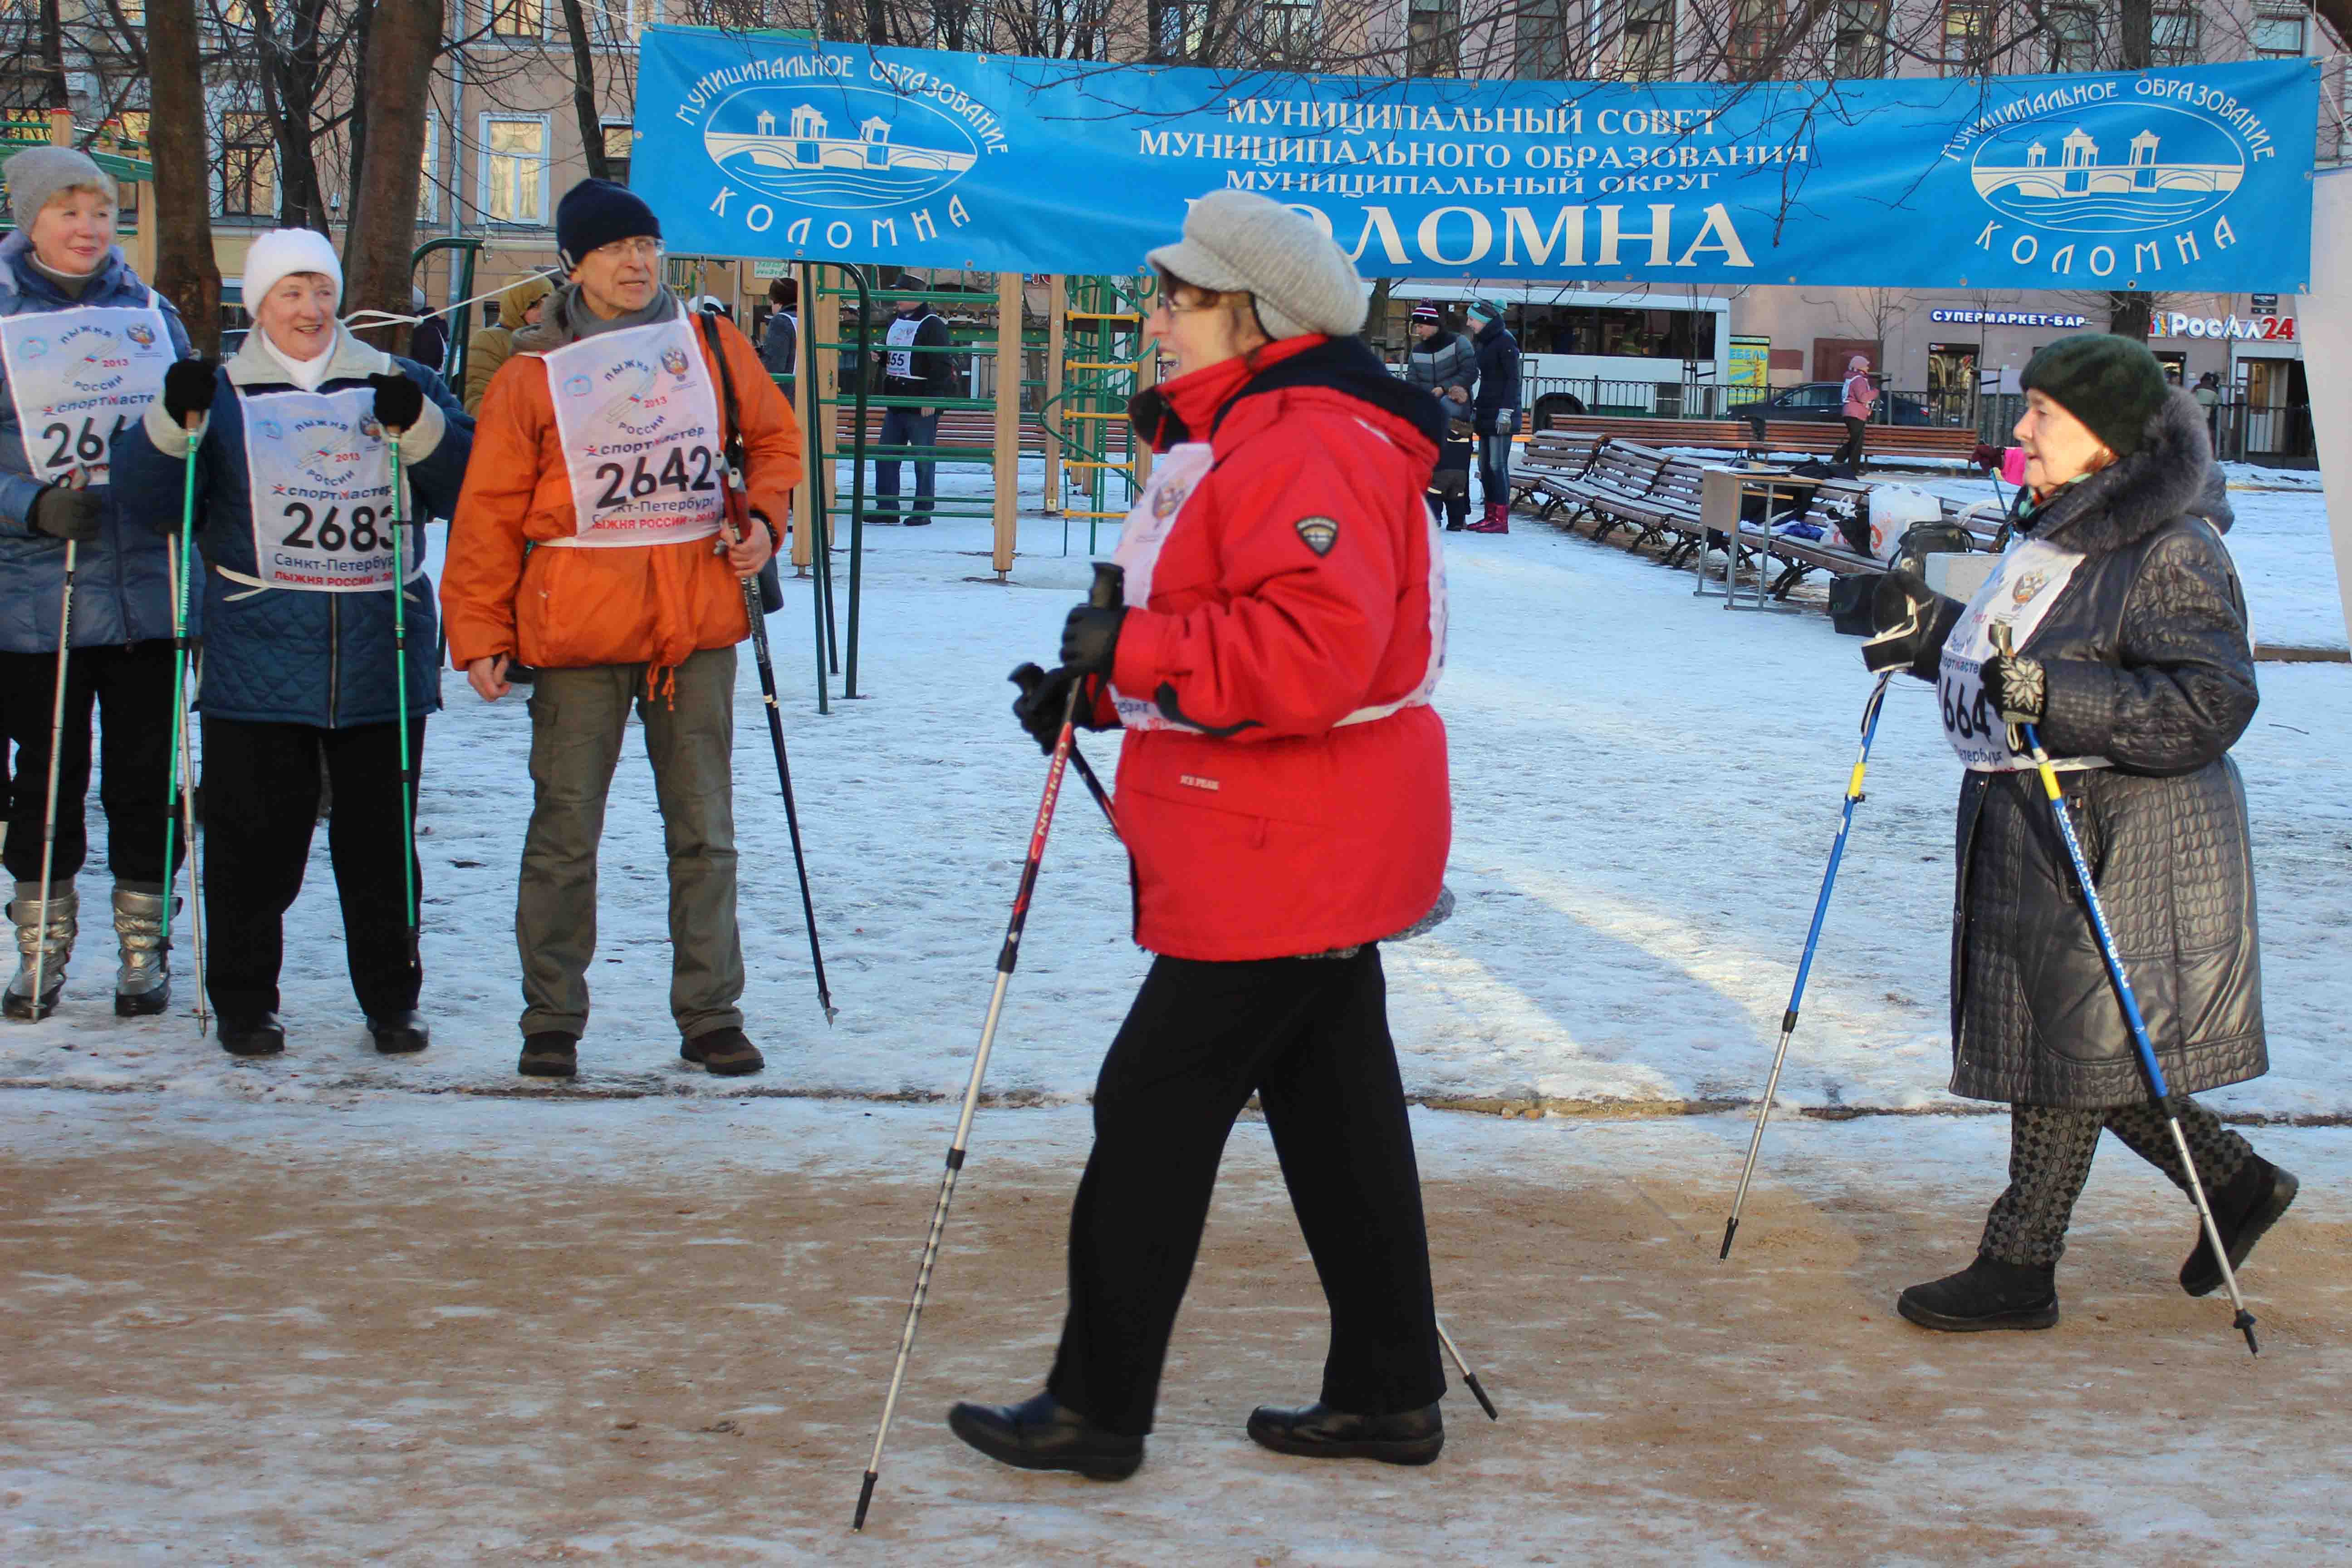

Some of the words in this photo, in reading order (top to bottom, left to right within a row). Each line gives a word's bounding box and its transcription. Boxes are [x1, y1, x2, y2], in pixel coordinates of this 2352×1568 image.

[676, 55, 853, 126] МУНИЦИПАЛЬНОЕ
[869, 60, 1009, 155] ОБРАЗОВАНИЕ
[1226, 98, 1583, 135] МУНИЦИПАЛЬНЫЙ
[1597, 108, 1721, 135] СОВЕТ
[1942, 82, 2119, 162] МУНИЦИПАЛЬНОЕ
[2135, 78, 2275, 162] ОБРАЗОВАНИЕ
[1139, 130, 1510, 167] МУНИЦИПАЛЬНОГО
[1525, 145, 1808, 170] ОБРАЗОВАНИЯ
[1226, 170, 1583, 198] МУНИЦИПАЛЬНЫЙ
[1599, 172, 1720, 194] ОКРУГ
[709, 186, 971, 249] КОЛОМНА
[1975, 215, 2236, 277] КОЛОМНА
[1932, 310, 2085, 327] СУПЕРМАРКЕТ-БАР
[102, 358, 129, 368] 2013
[1729, 348, 1768, 360] ЕБЕЛЬ
[643, 396, 667, 408] 2013
[595, 445, 715, 509] 2642
[281, 502, 403, 553] 2683
[639, 516, 687, 529] РОССИИ
[274, 553, 395, 573] Санкт-Петербур
[1938, 674, 1992, 745] 664
